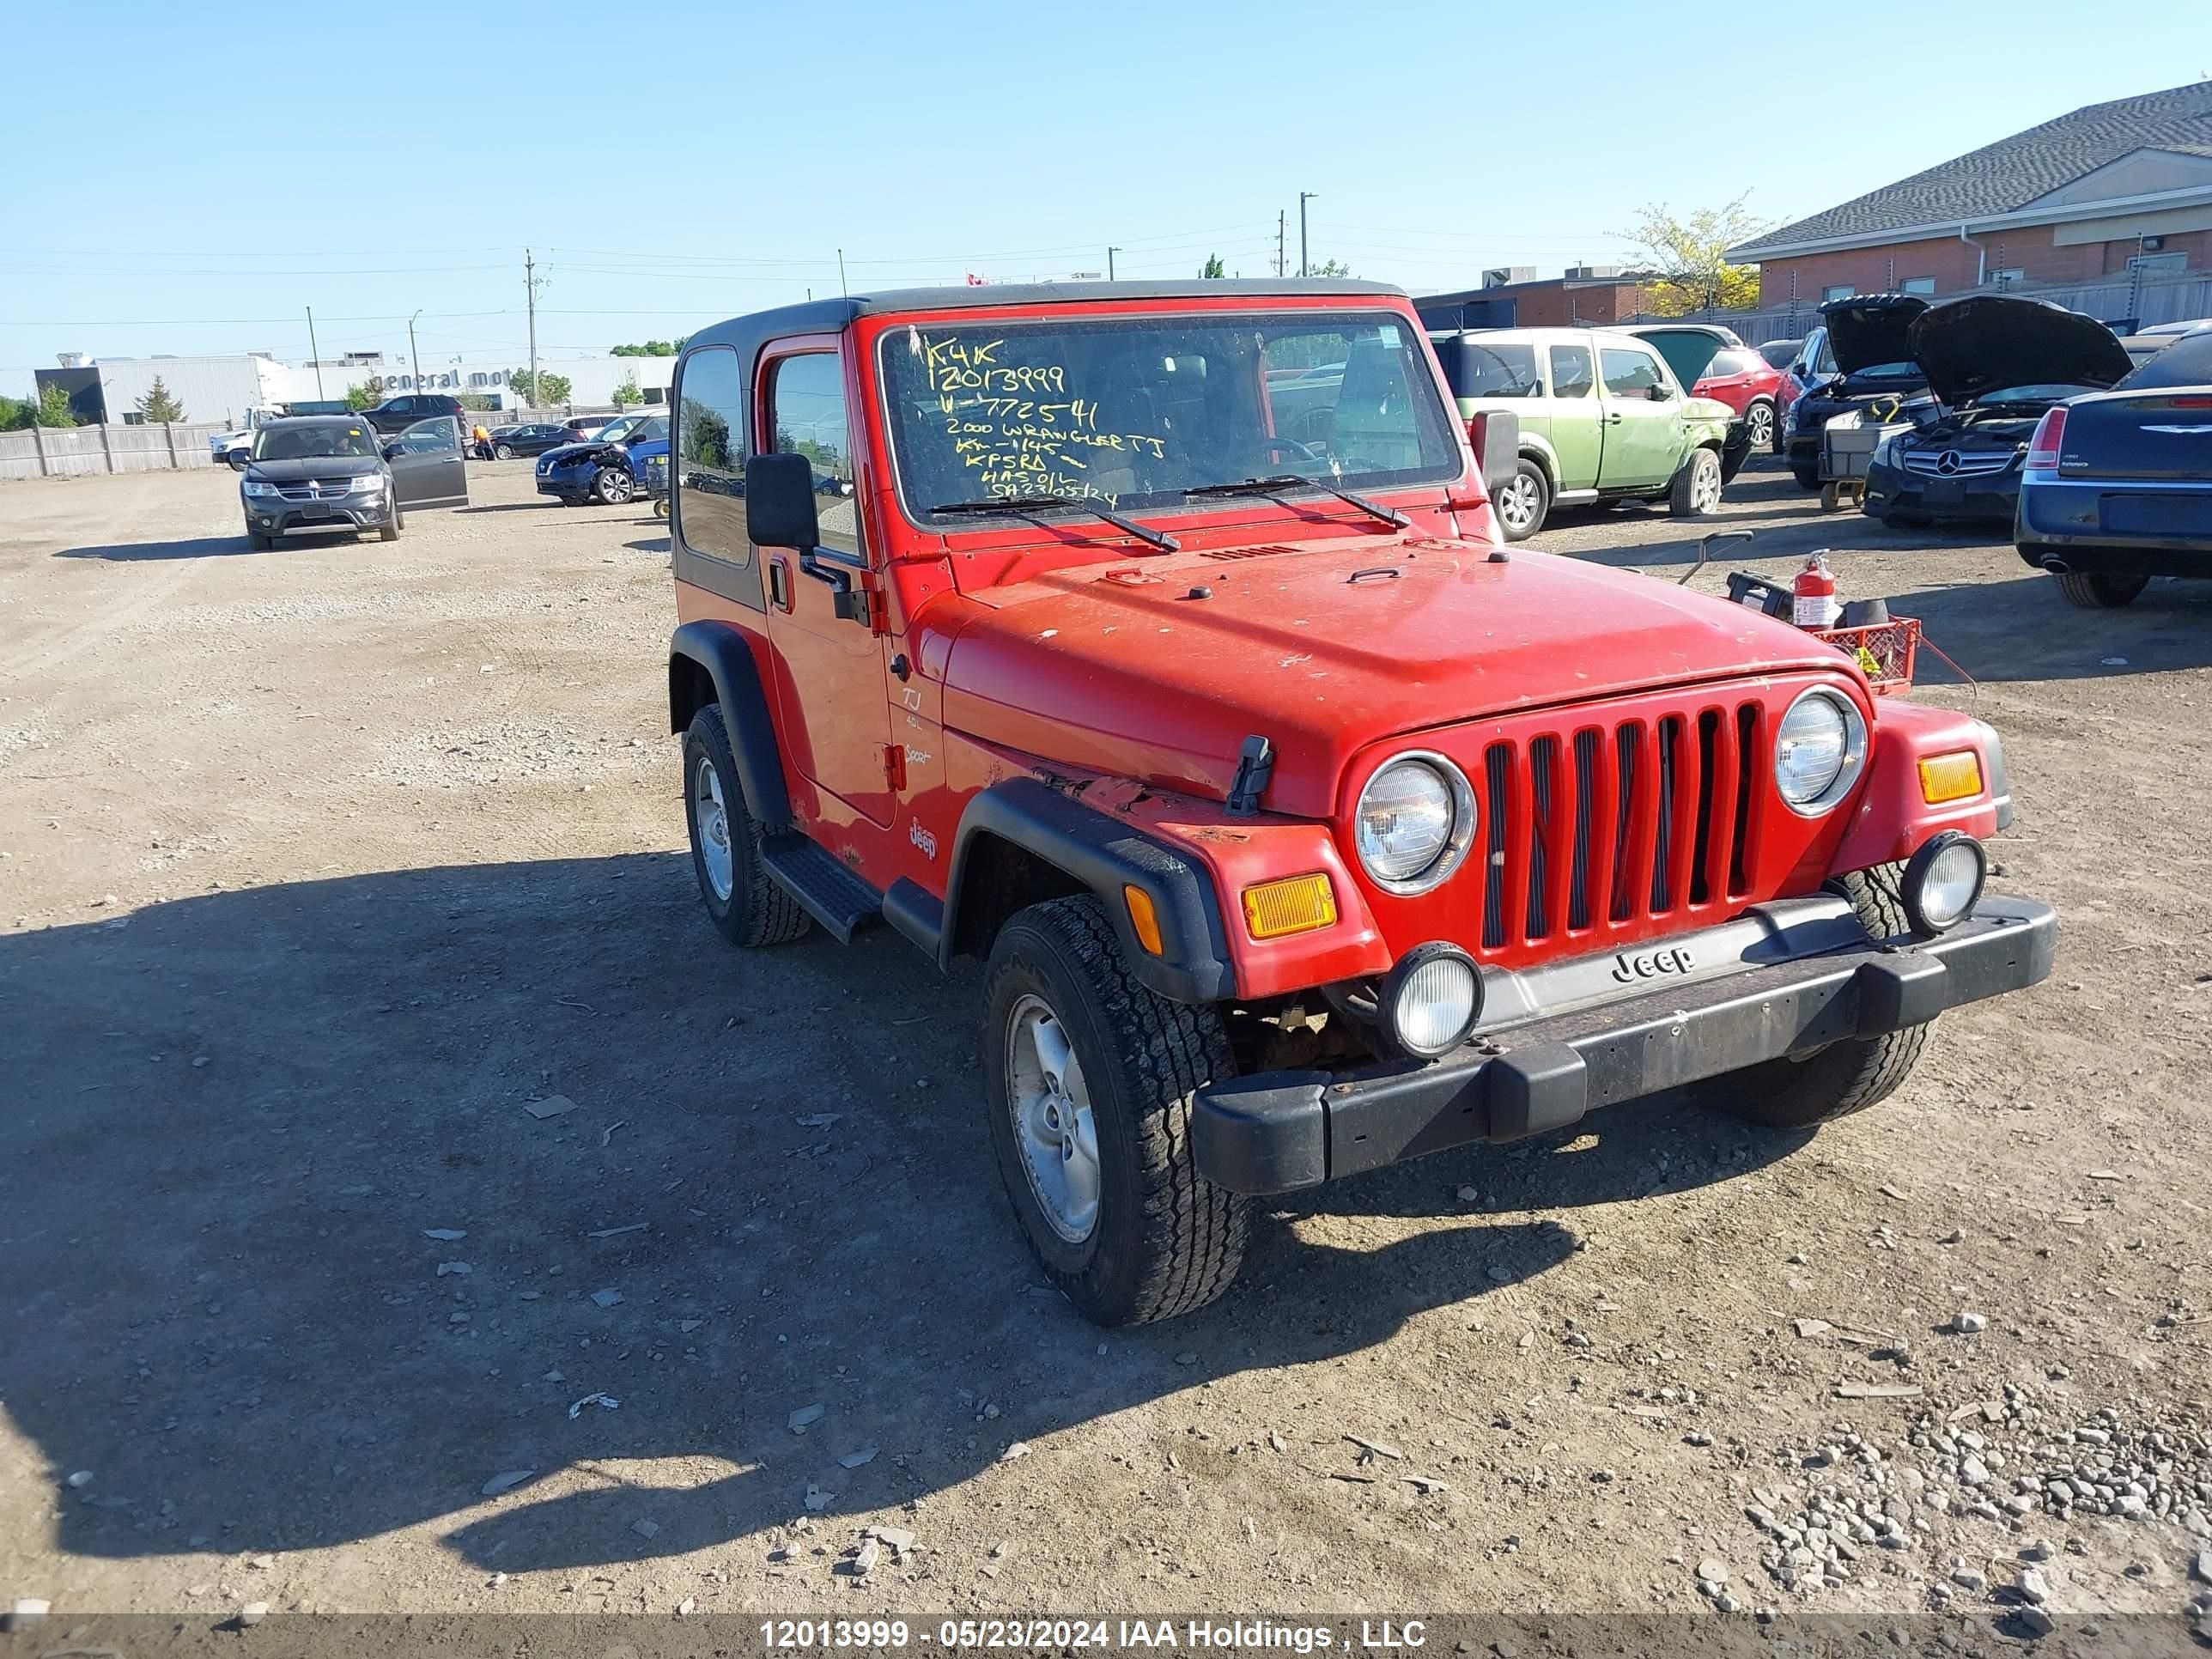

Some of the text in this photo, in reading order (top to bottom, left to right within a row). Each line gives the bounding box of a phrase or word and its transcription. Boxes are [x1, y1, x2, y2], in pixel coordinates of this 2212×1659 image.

[924, 335, 1003, 368] K4K
[929, 366, 1064, 393] 12013999
[946, 418, 1165, 459] 2000 WRANGLER TJ
[902, 687, 922, 711] TJ
[905, 744, 932, 767] Sport
[909, 818, 937, 860] Jeep
[1612, 946, 1697, 983] Jeep
